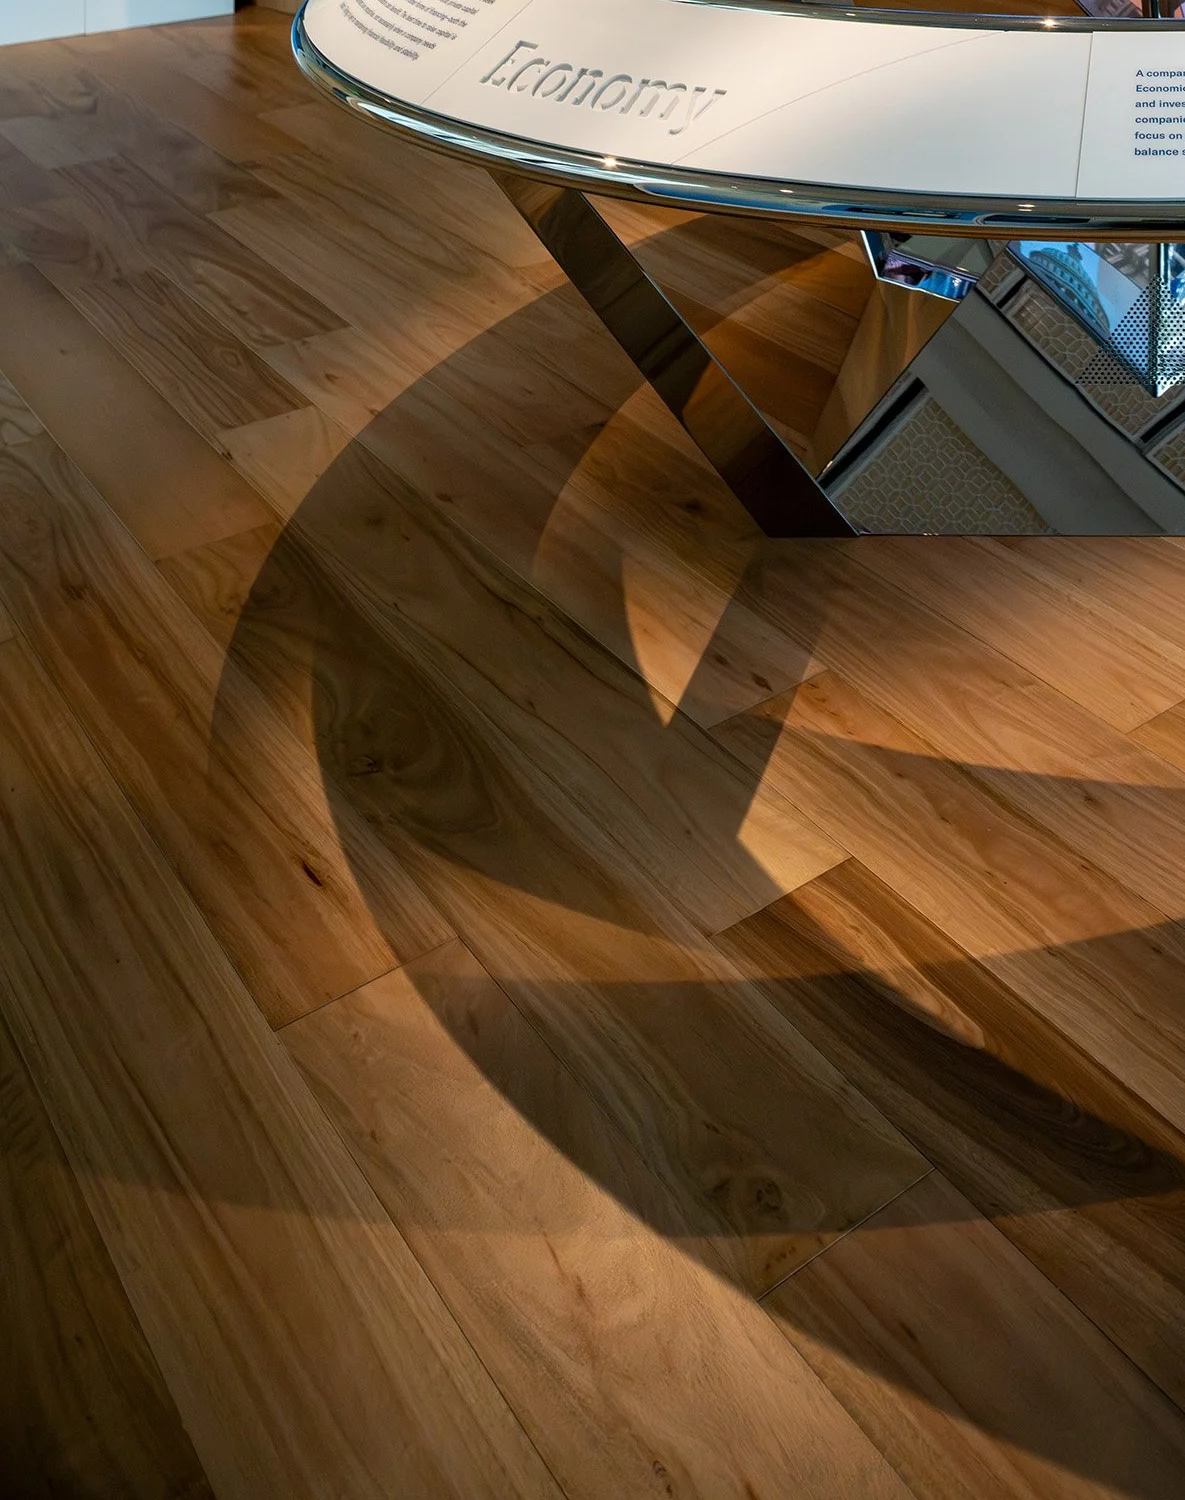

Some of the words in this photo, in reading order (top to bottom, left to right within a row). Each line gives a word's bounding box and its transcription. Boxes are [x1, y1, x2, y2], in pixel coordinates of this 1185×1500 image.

[1135, 69, 1144, 77] A
[478, 40, 727, 135] Economy
[1134, 131, 1165, 139] focus
[1134, 147, 1179, 156] balance
